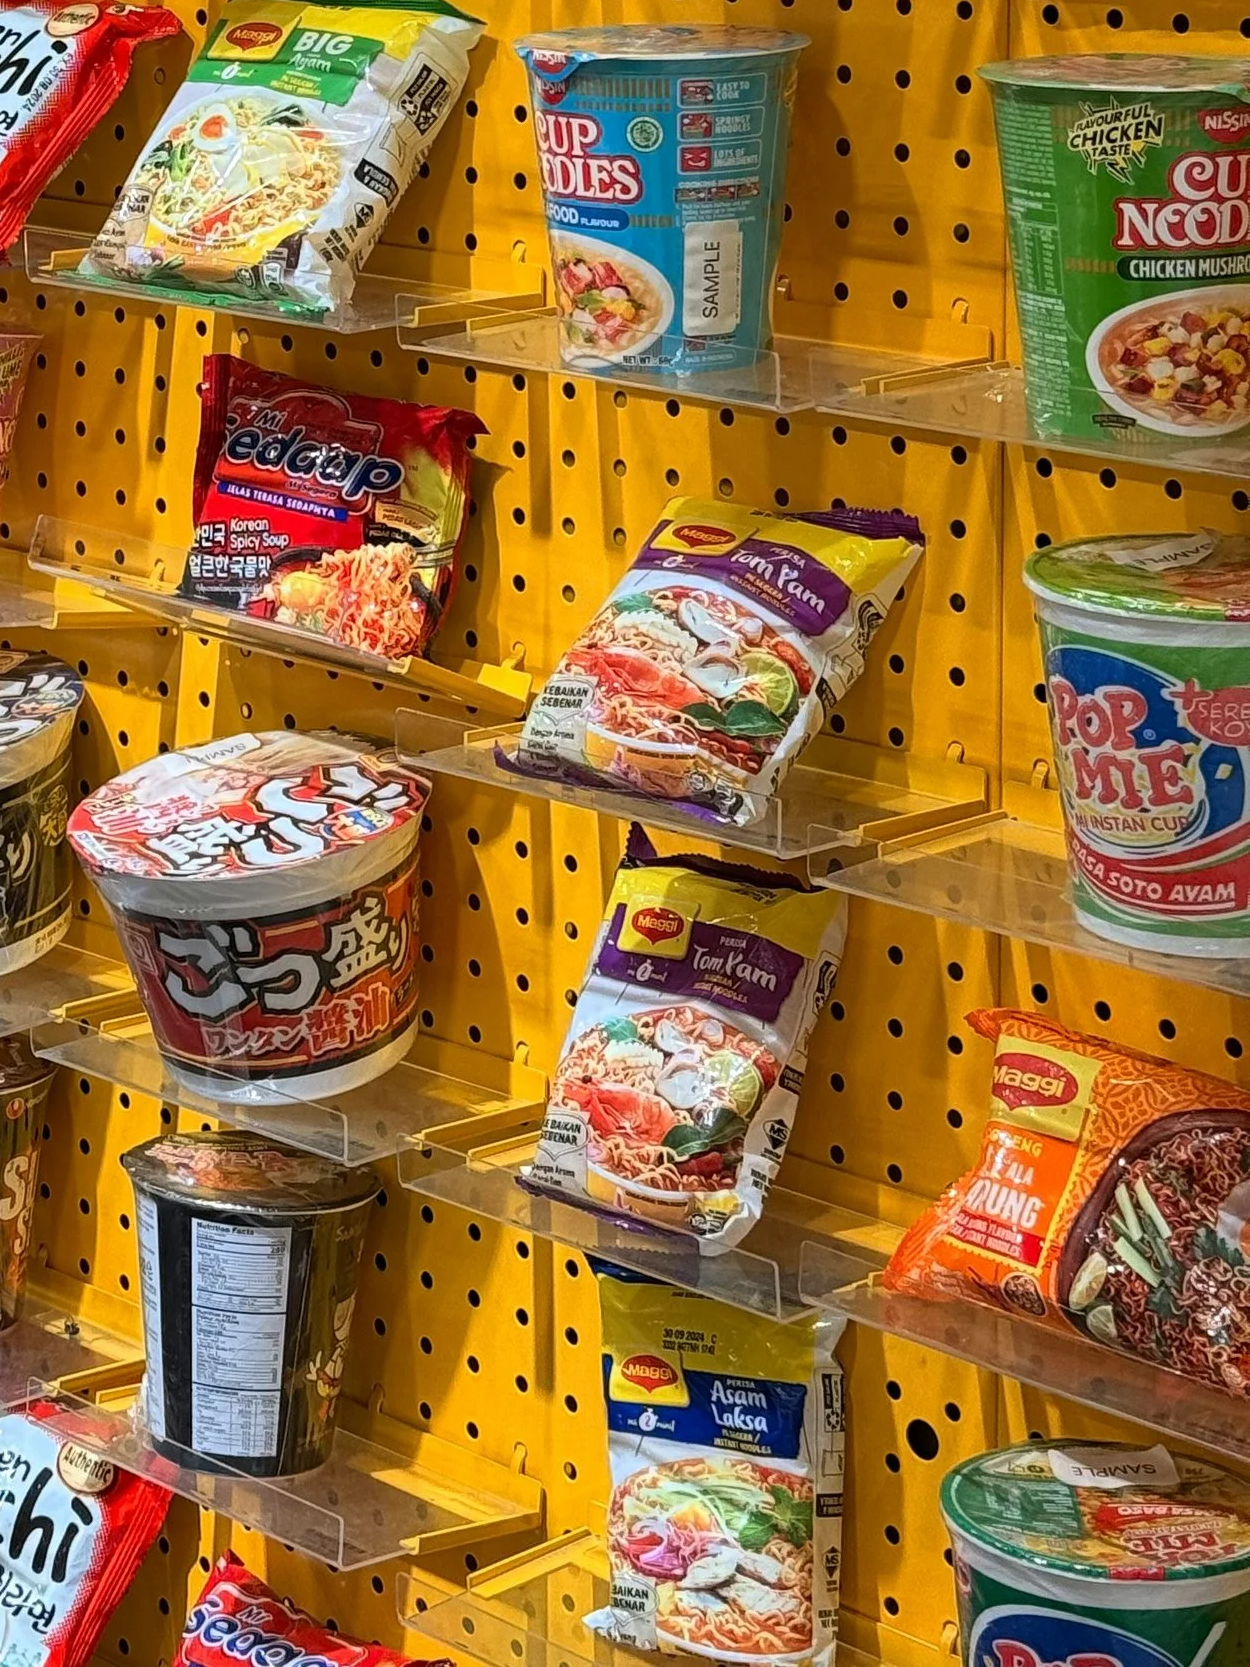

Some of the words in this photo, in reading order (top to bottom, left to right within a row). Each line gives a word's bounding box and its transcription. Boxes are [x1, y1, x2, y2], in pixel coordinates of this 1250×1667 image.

[292, 31, 353, 54] BIG
[289, 54, 331, 73] Ayam
[739, 81, 751, 90] TO
[1074, 105, 1152, 134] FLAVOURFUL
[1068, 119, 1164, 148] CHICKEN
[1090, 142, 1132, 158] TASTE
[1130, 258, 1196, 278] CHICKEN
[703, 241, 720, 319] SAMPLE
[254, 410, 286, 431] Mi
[227, 484, 250, 496] JELAS
[253, 490, 284, 506] TERASA
[286, 497, 336, 518] SEDAPNYA
[230, 518, 269, 531] Korean
[230, 533, 260, 550] Spicy
[262, 534, 289, 547] Soup
[728, 548, 771, 583] Tom
[775, 563, 827, 615] Yam
[540, 696, 583, 710] SEBENAR
[1051, 681, 1148, 749] POP
[1071, 744, 1195, 811] MIE
[1090, 816, 1146, 833] INSTAN
[1151, 816, 1191, 832] CUP
[1071, 838, 1105, 881] RASA
[1107, 871, 1163, 900] SOTO
[1169, 881, 1236, 902] AYAM
[637, 912, 679, 934] Maggi
[692, 943, 723, 973] Tom
[724, 956, 778, 993] Yam
[993, 1065, 1067, 1098] Maggi
[197, 1222, 231, 1234] Nutrition
[232, 1226, 255, 1236] Facts
[626, 1365, 672, 1381] Maggi
[711, 1380, 767, 1409] Asam
[712, 1407, 768, 1433] Laksa
[63, 1445, 112, 1485] Authentic
[1071, 1464, 1157, 1477] SAMPLE
[825, 1553, 840, 1566] MS
